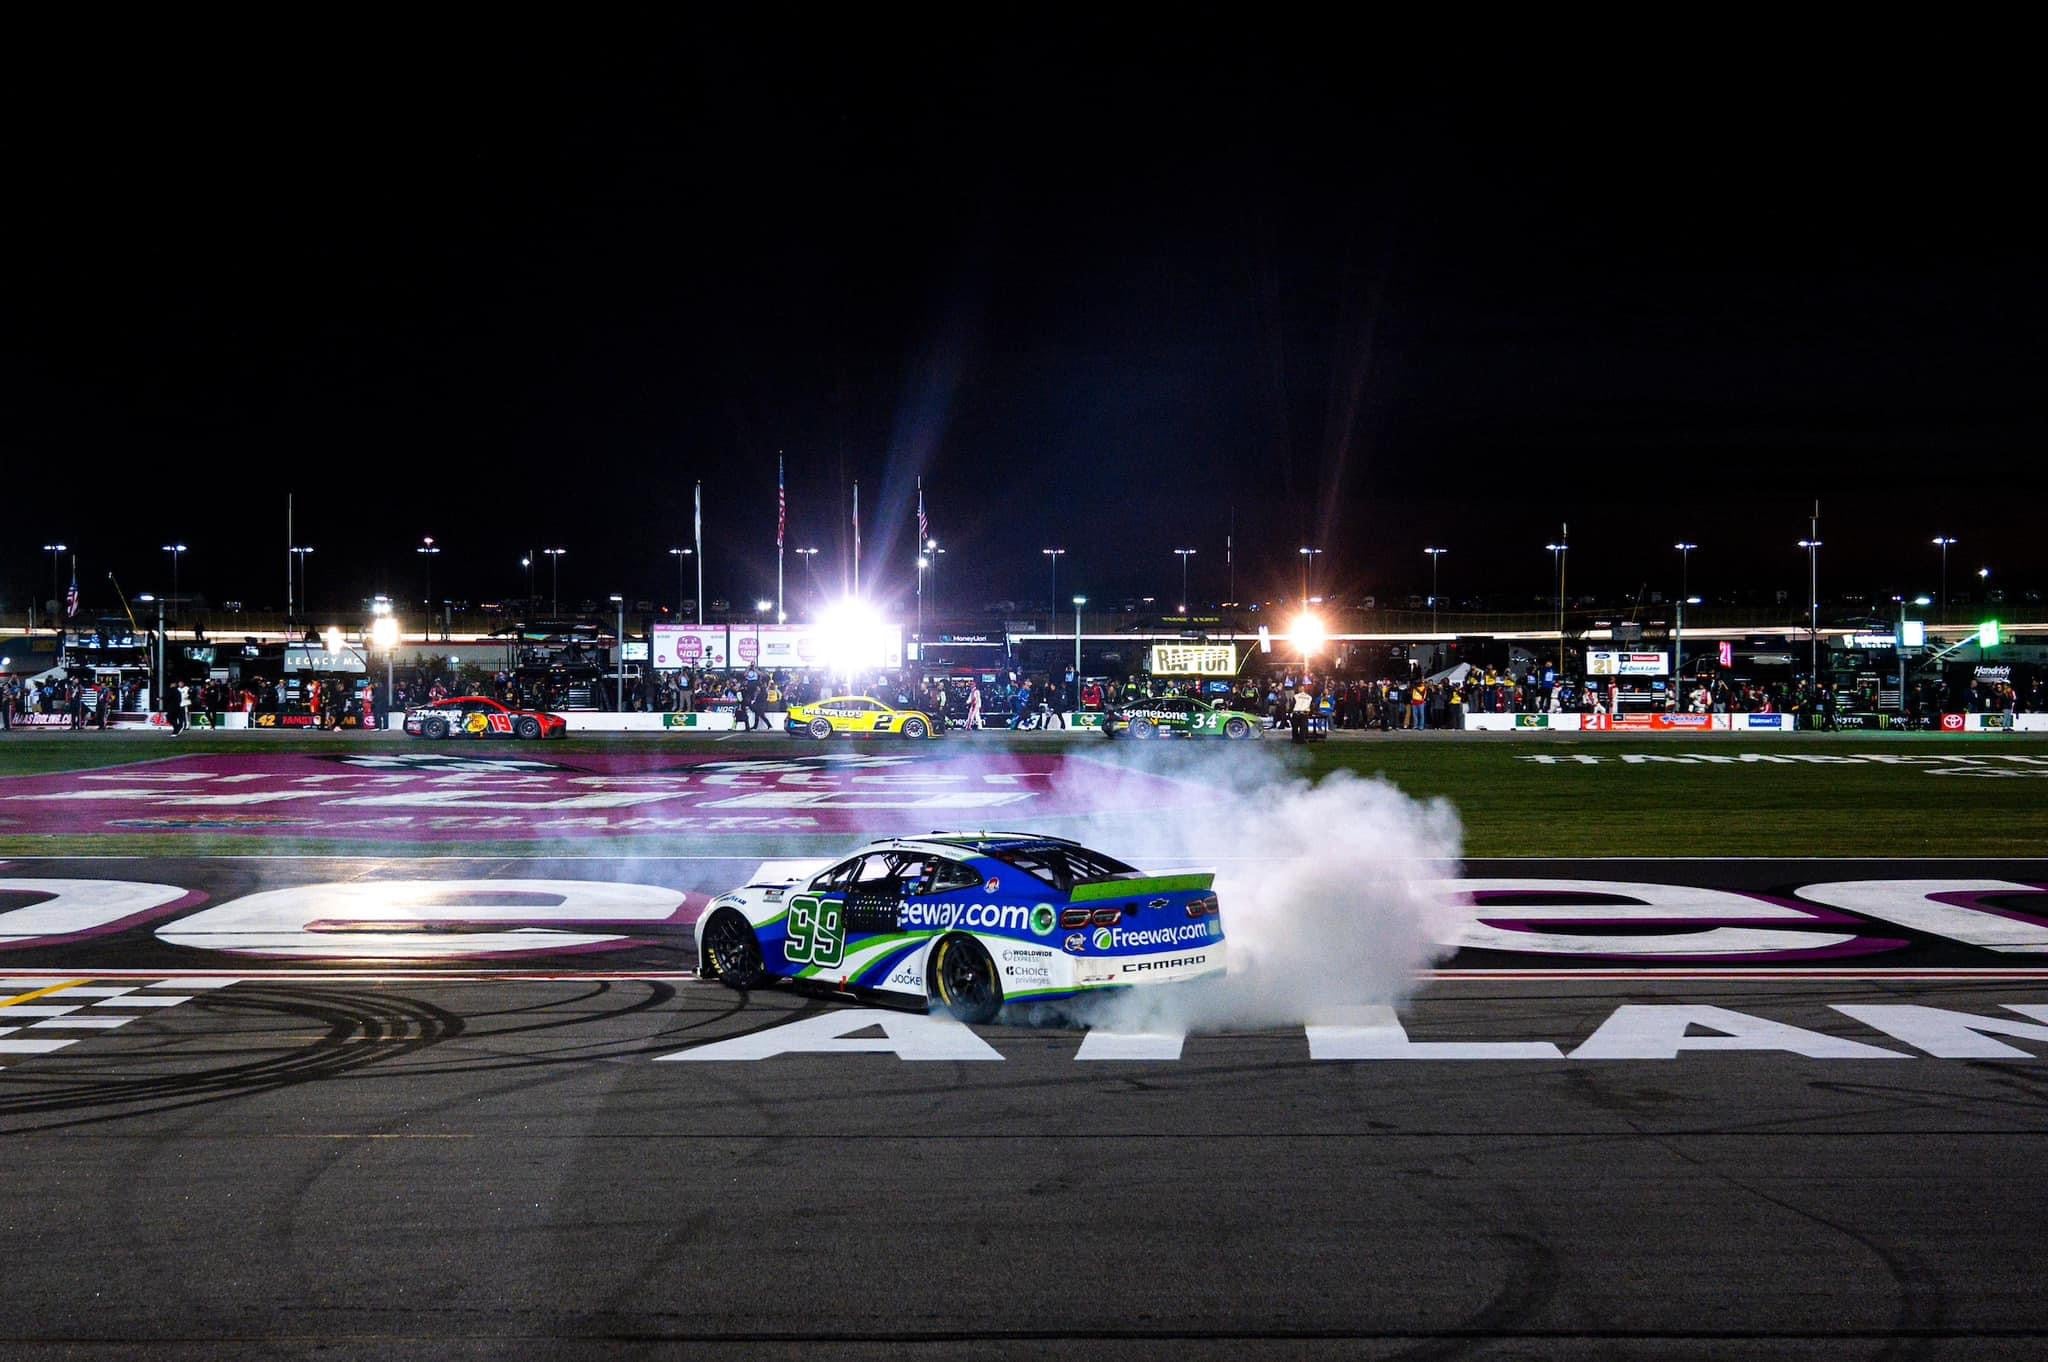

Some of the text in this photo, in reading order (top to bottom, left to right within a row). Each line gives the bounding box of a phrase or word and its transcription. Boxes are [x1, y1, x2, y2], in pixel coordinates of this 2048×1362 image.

[287, 657, 337, 665] LEGACY
[1157, 649, 1230, 671] RAPTOR
[1594, 660, 1612, 673] 21
[1974, 666, 2011, 676] Hendrick
[416, 709, 462, 718] TRACKER
[258, 715, 276, 727] 42
[488, 713, 514, 733] 19
[873, 714, 894, 731] 2
[1192, 713, 1218, 729] 34
[1584, 714, 1606, 730] 21
[1750, 717, 1773, 725] Walmart
[2, 788, 1044, 810] 400
[784, 895, 847, 969] 99
[1112, 922, 1208, 948] Freeway.com
[1013, 949, 1053, 957] WORLDWIDE
[1122, 955, 1206, 973] CAMARO
[1015, 966, 1049, 977] CHOICE
[891, 973, 921, 986] JOCKE
[1015, 976, 1050, 985] privileges
